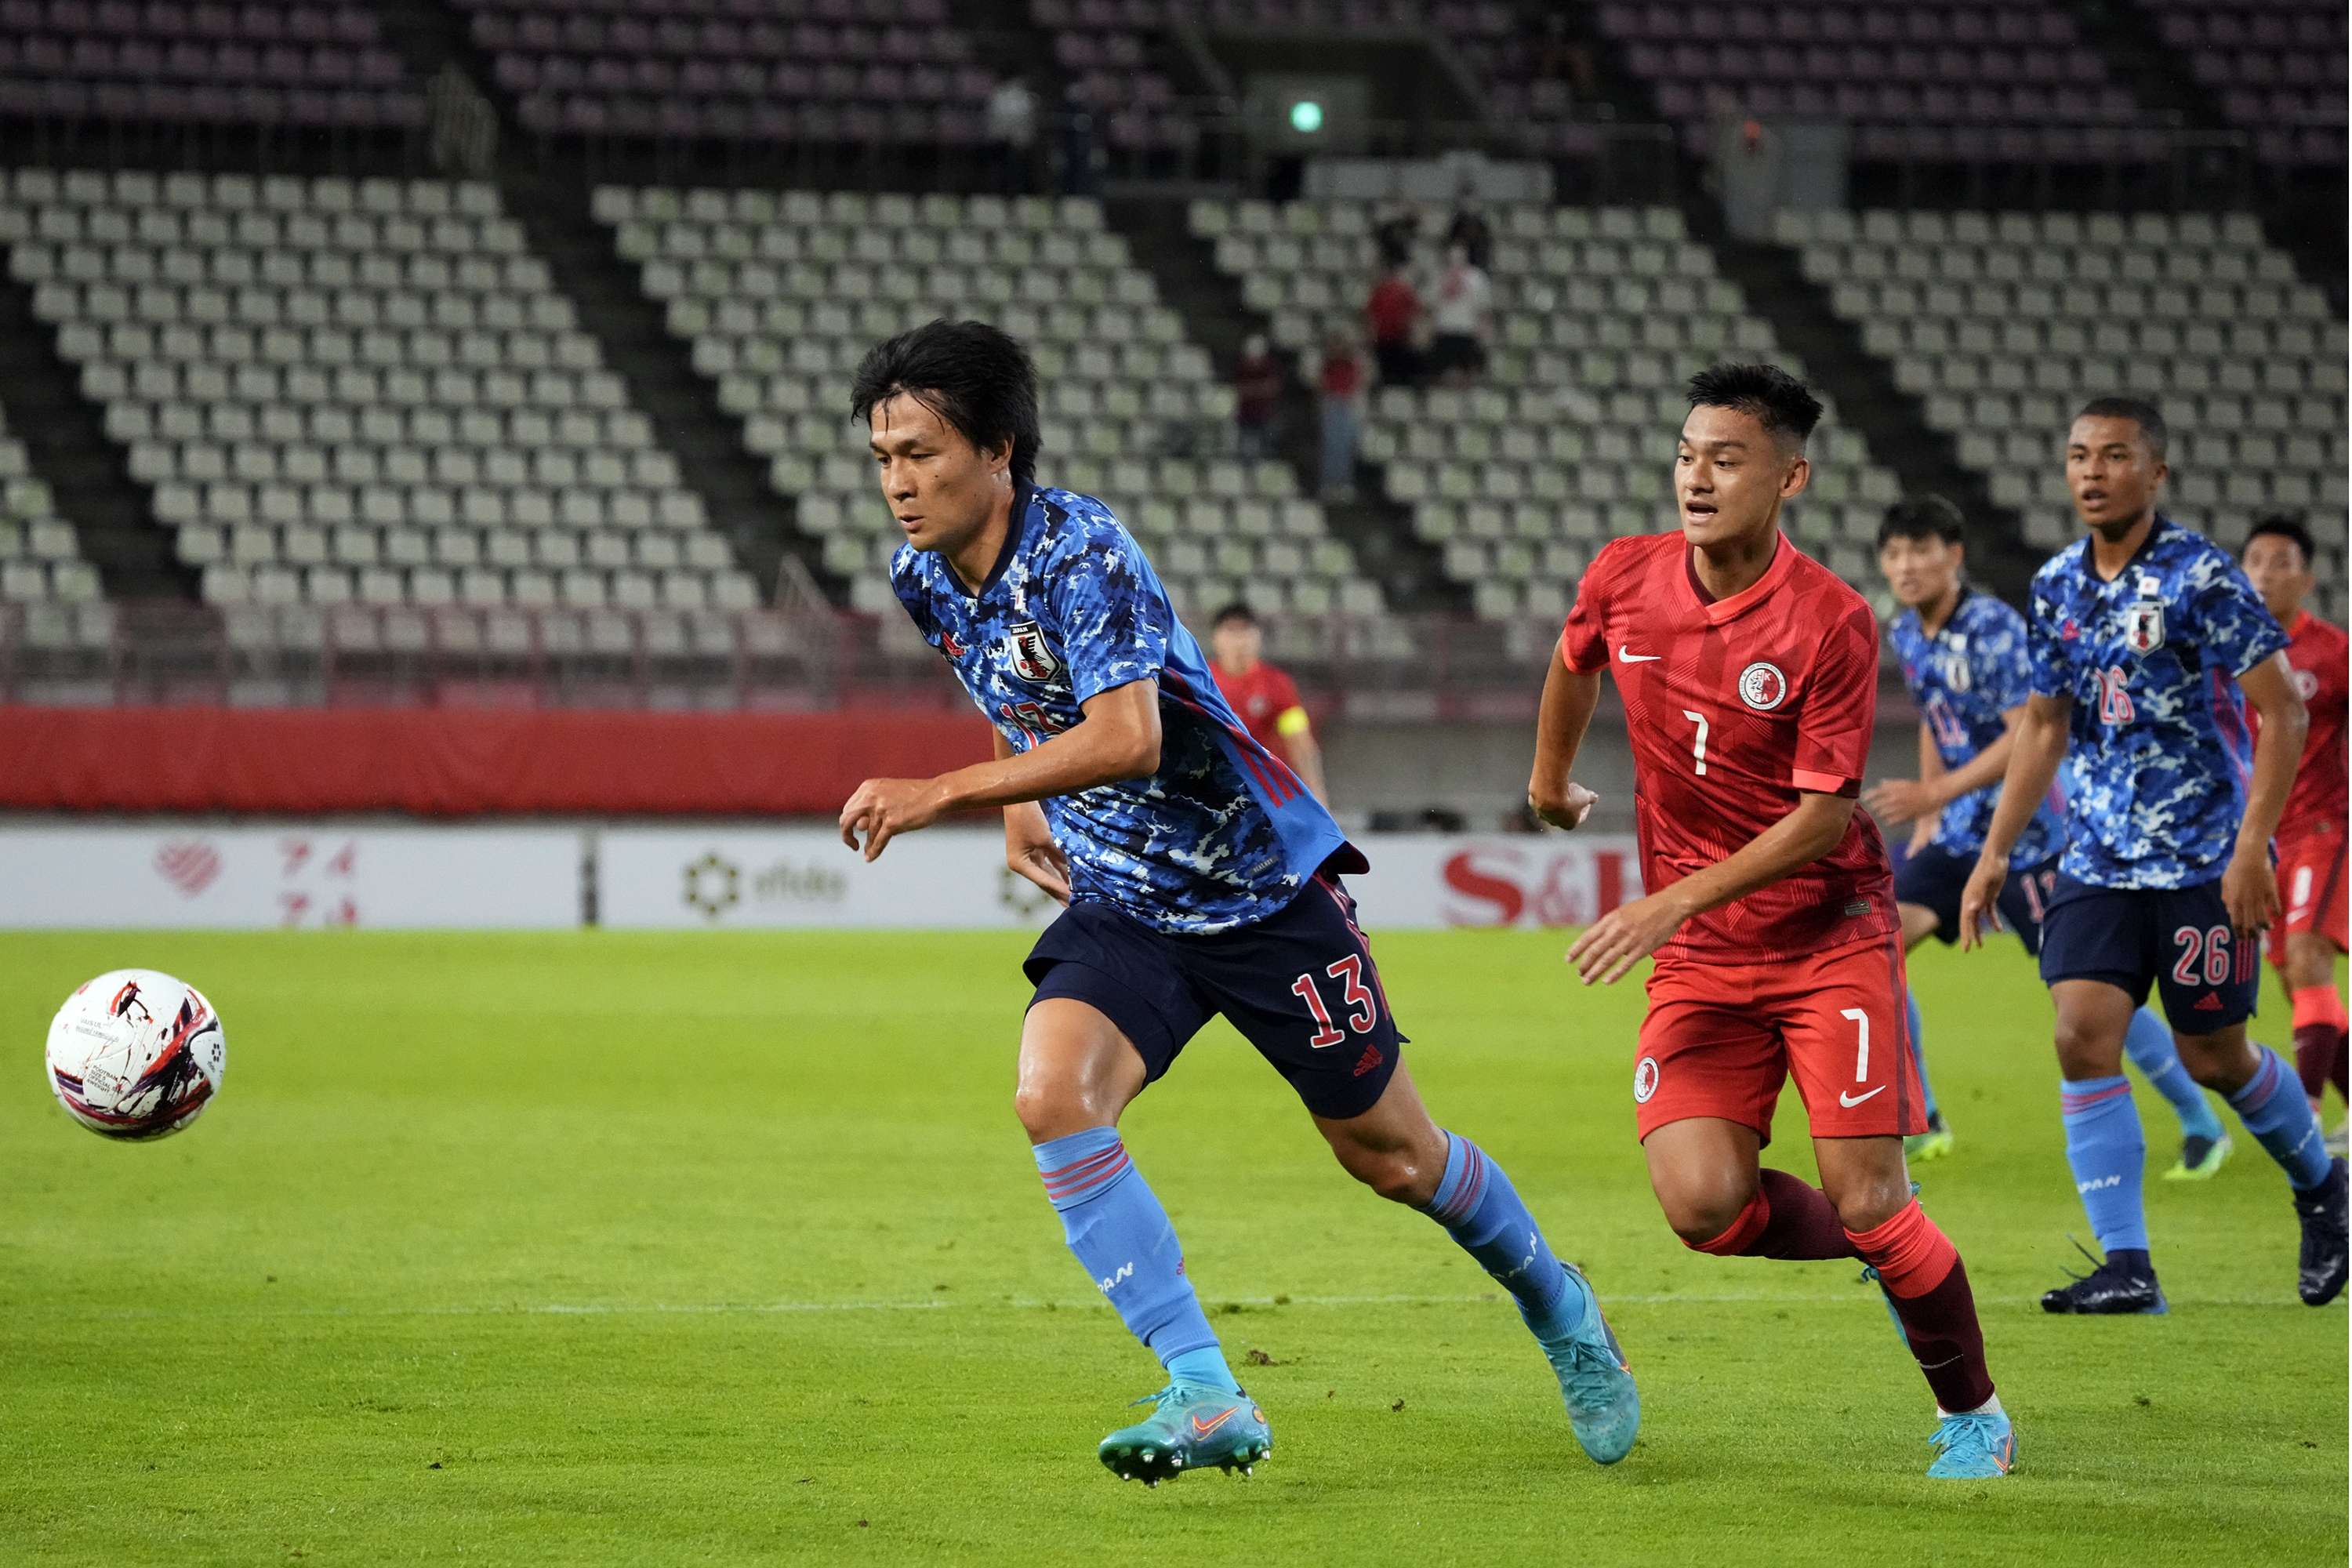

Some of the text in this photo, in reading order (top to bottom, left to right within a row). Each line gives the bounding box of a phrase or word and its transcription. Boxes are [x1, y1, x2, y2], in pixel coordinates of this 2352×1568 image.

[2094, 664, 2136, 725] 26
[1682, 710, 1709, 775] 7
[2172, 924, 2231, 986] 26
[1291, 953, 1377, 1048] 13
[1839, 1008, 1869, 1082] 7
